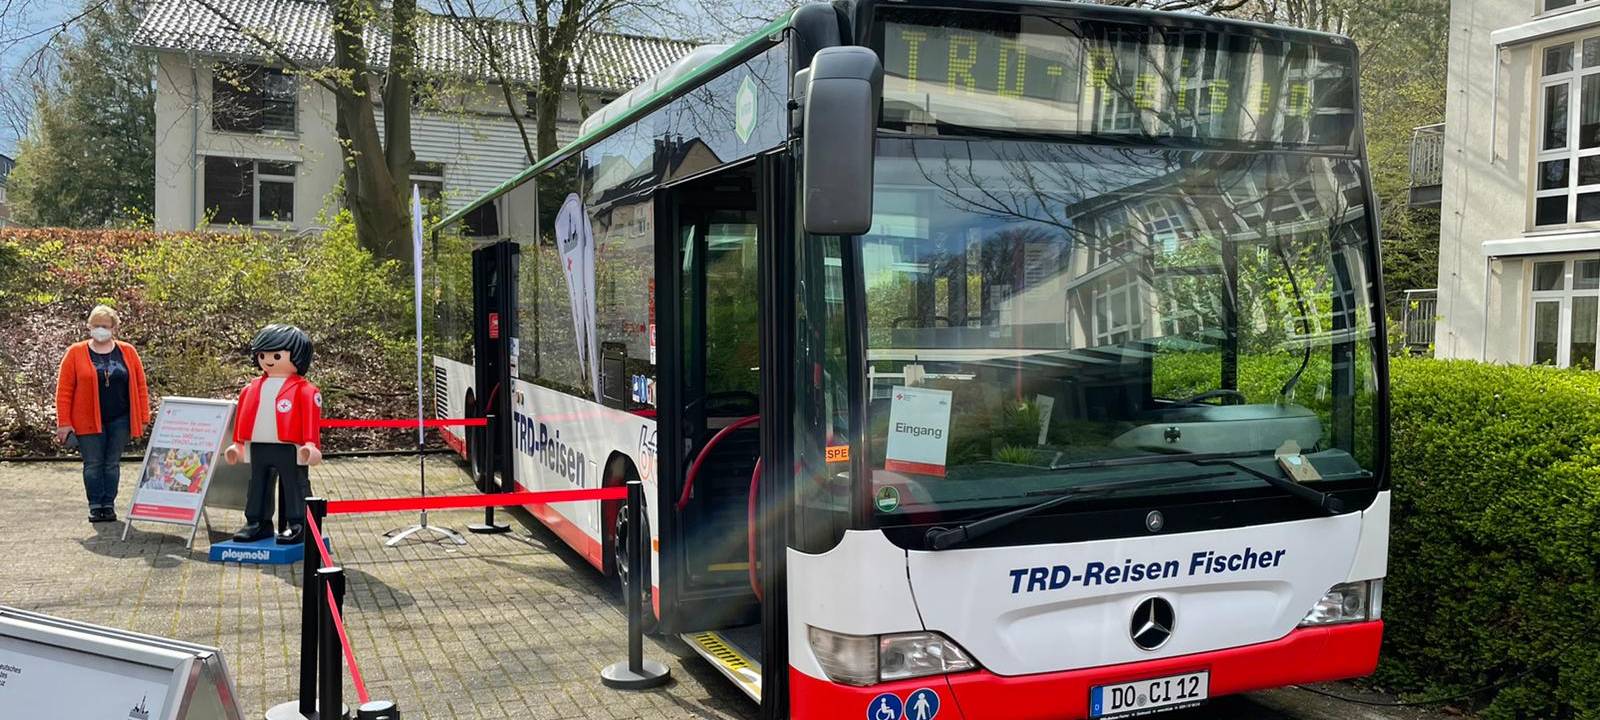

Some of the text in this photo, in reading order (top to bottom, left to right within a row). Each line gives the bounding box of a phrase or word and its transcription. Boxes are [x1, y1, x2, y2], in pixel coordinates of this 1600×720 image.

[895, 422, 943, 439] Eingang
[513, 411, 586, 488] TRD-Reisen
[826, 448, 848, 459] SPE
[221, 548, 270, 562] playmobil
[1009, 547, 1286, 594] TRD-Reisen Fischer
[1111, 676, 1199, 709] DO CI 12
